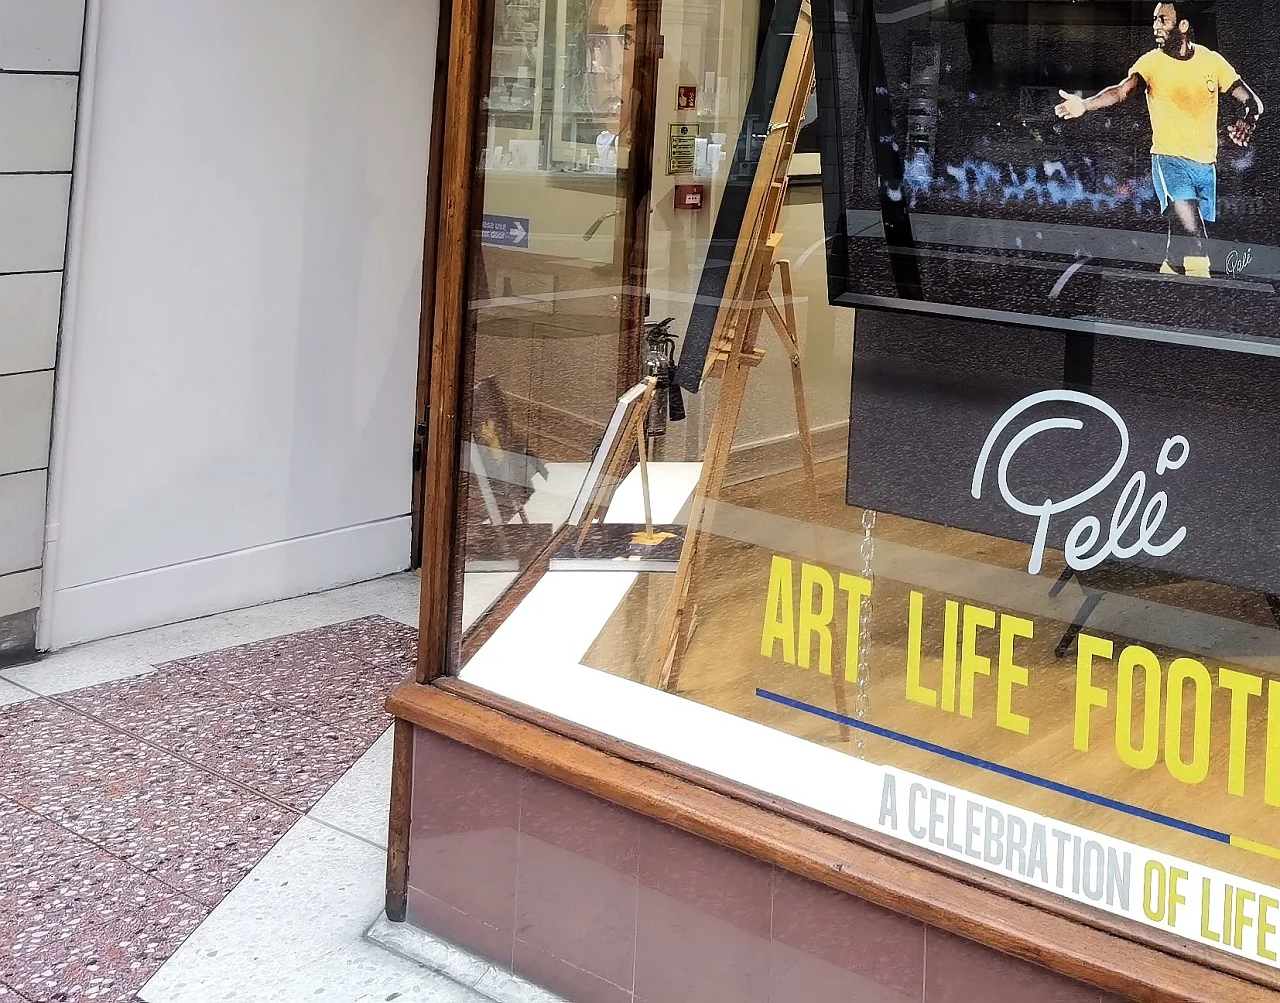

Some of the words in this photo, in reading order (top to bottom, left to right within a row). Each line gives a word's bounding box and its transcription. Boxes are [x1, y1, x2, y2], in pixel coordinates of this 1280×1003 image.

[760, 554, 872, 684] ART
[905, 590, 1034, 736] LIFE
[878, 773, 898, 831] A
[907, 782, 1132, 912] CELEBRATION
[1142, 859, 1190, 927] OF
[1200, 876, 1280, 963] LIFE
